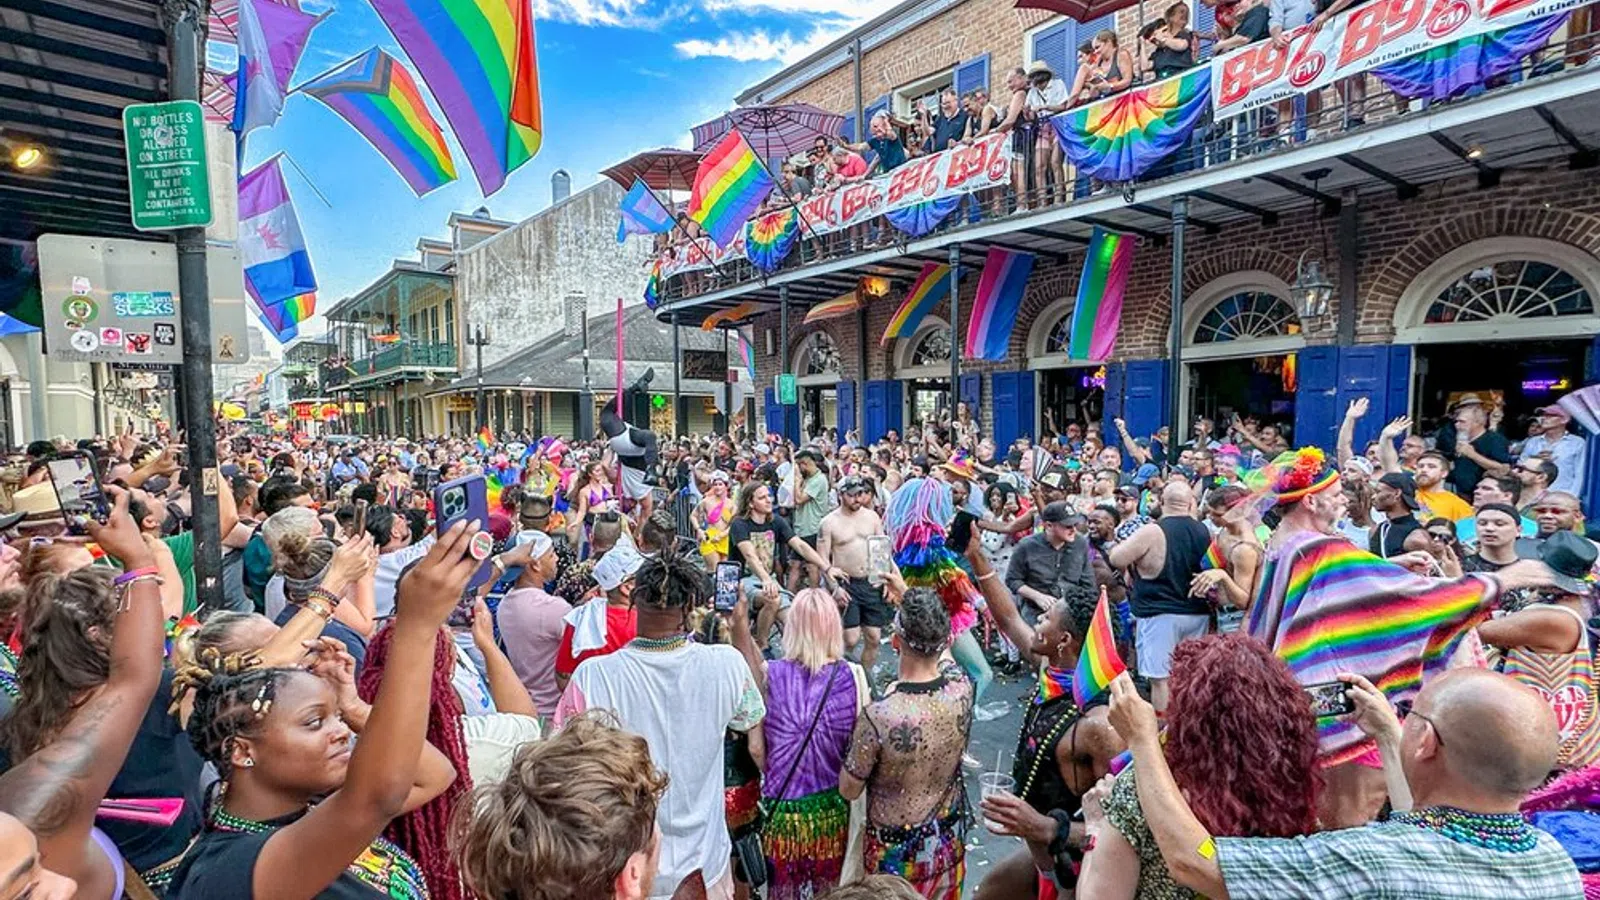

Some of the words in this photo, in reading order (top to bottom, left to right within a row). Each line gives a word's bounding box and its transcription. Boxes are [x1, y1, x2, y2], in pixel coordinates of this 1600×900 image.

[1527, 6, 1545, 17] All
[1549, 0, 1574, 12] the
[1295, 56, 1320, 80] FM
[132, 117, 147, 128] NO
[150, 112, 194, 127] BOTTLES
[139, 127, 153, 139] OR
[139, 152, 153, 163] ON
[156, 148, 194, 161] STREET
[160, 187, 191, 198] PLASTIC
[145, 197, 195, 209] CONTAINERS
